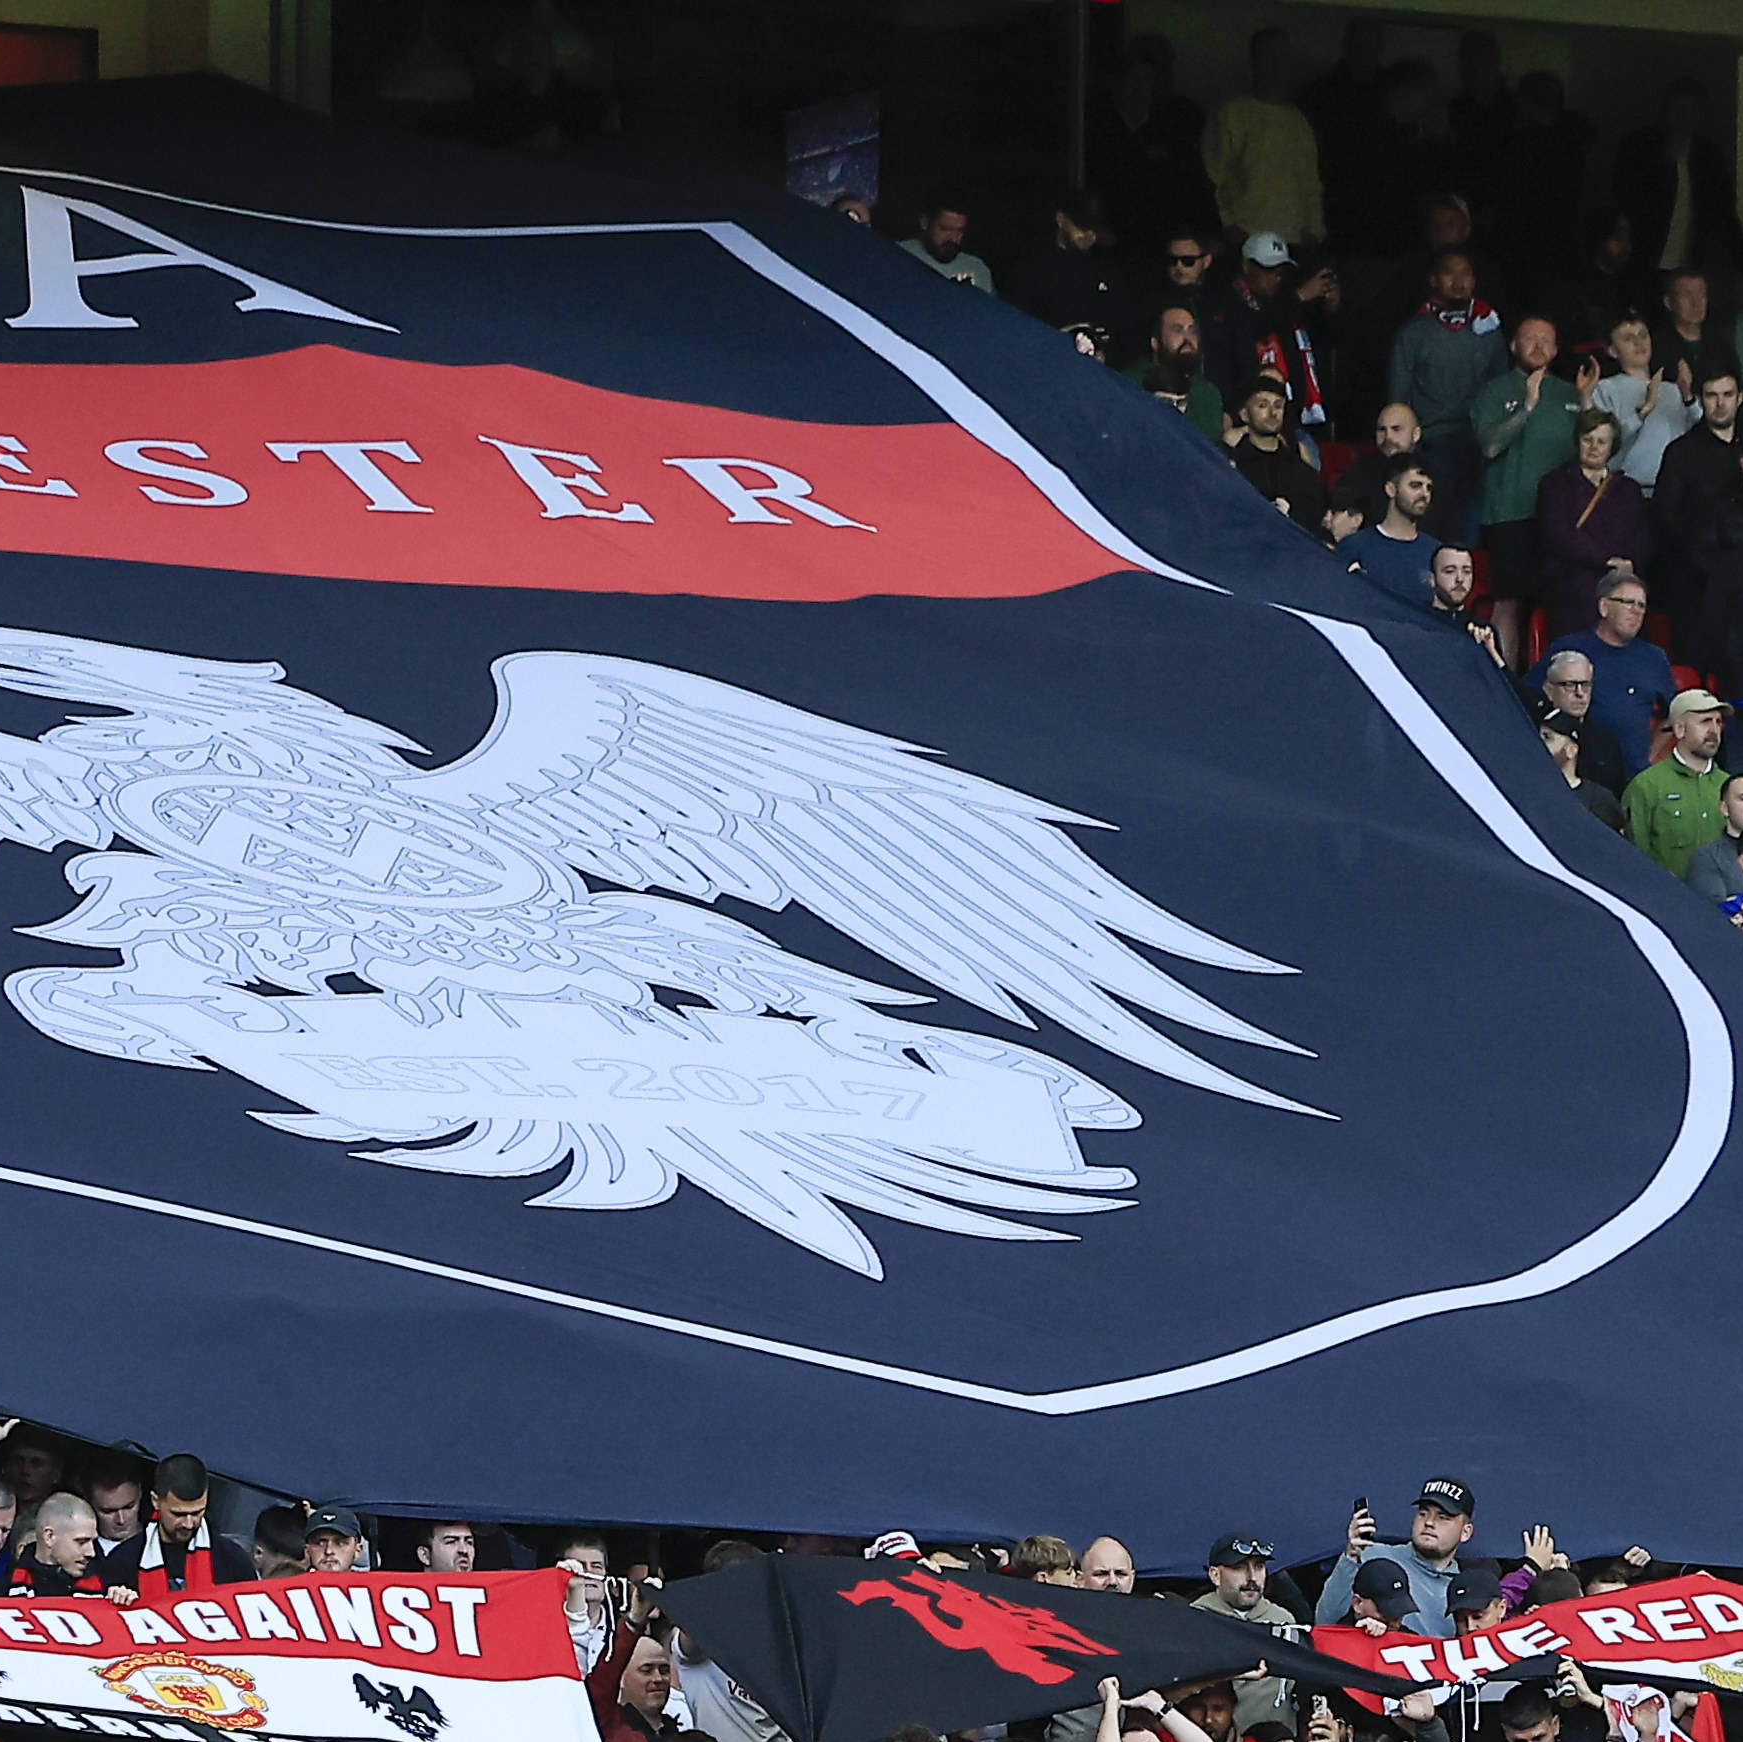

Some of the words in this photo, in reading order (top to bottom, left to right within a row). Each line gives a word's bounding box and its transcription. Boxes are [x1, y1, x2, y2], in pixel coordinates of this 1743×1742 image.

[279, 1050, 577, 1099] EST.
[591, 1055, 930, 1122] 2017
[132, 1588, 487, 1659] AGAINST
[1382, 1618, 1573, 1690] THE
